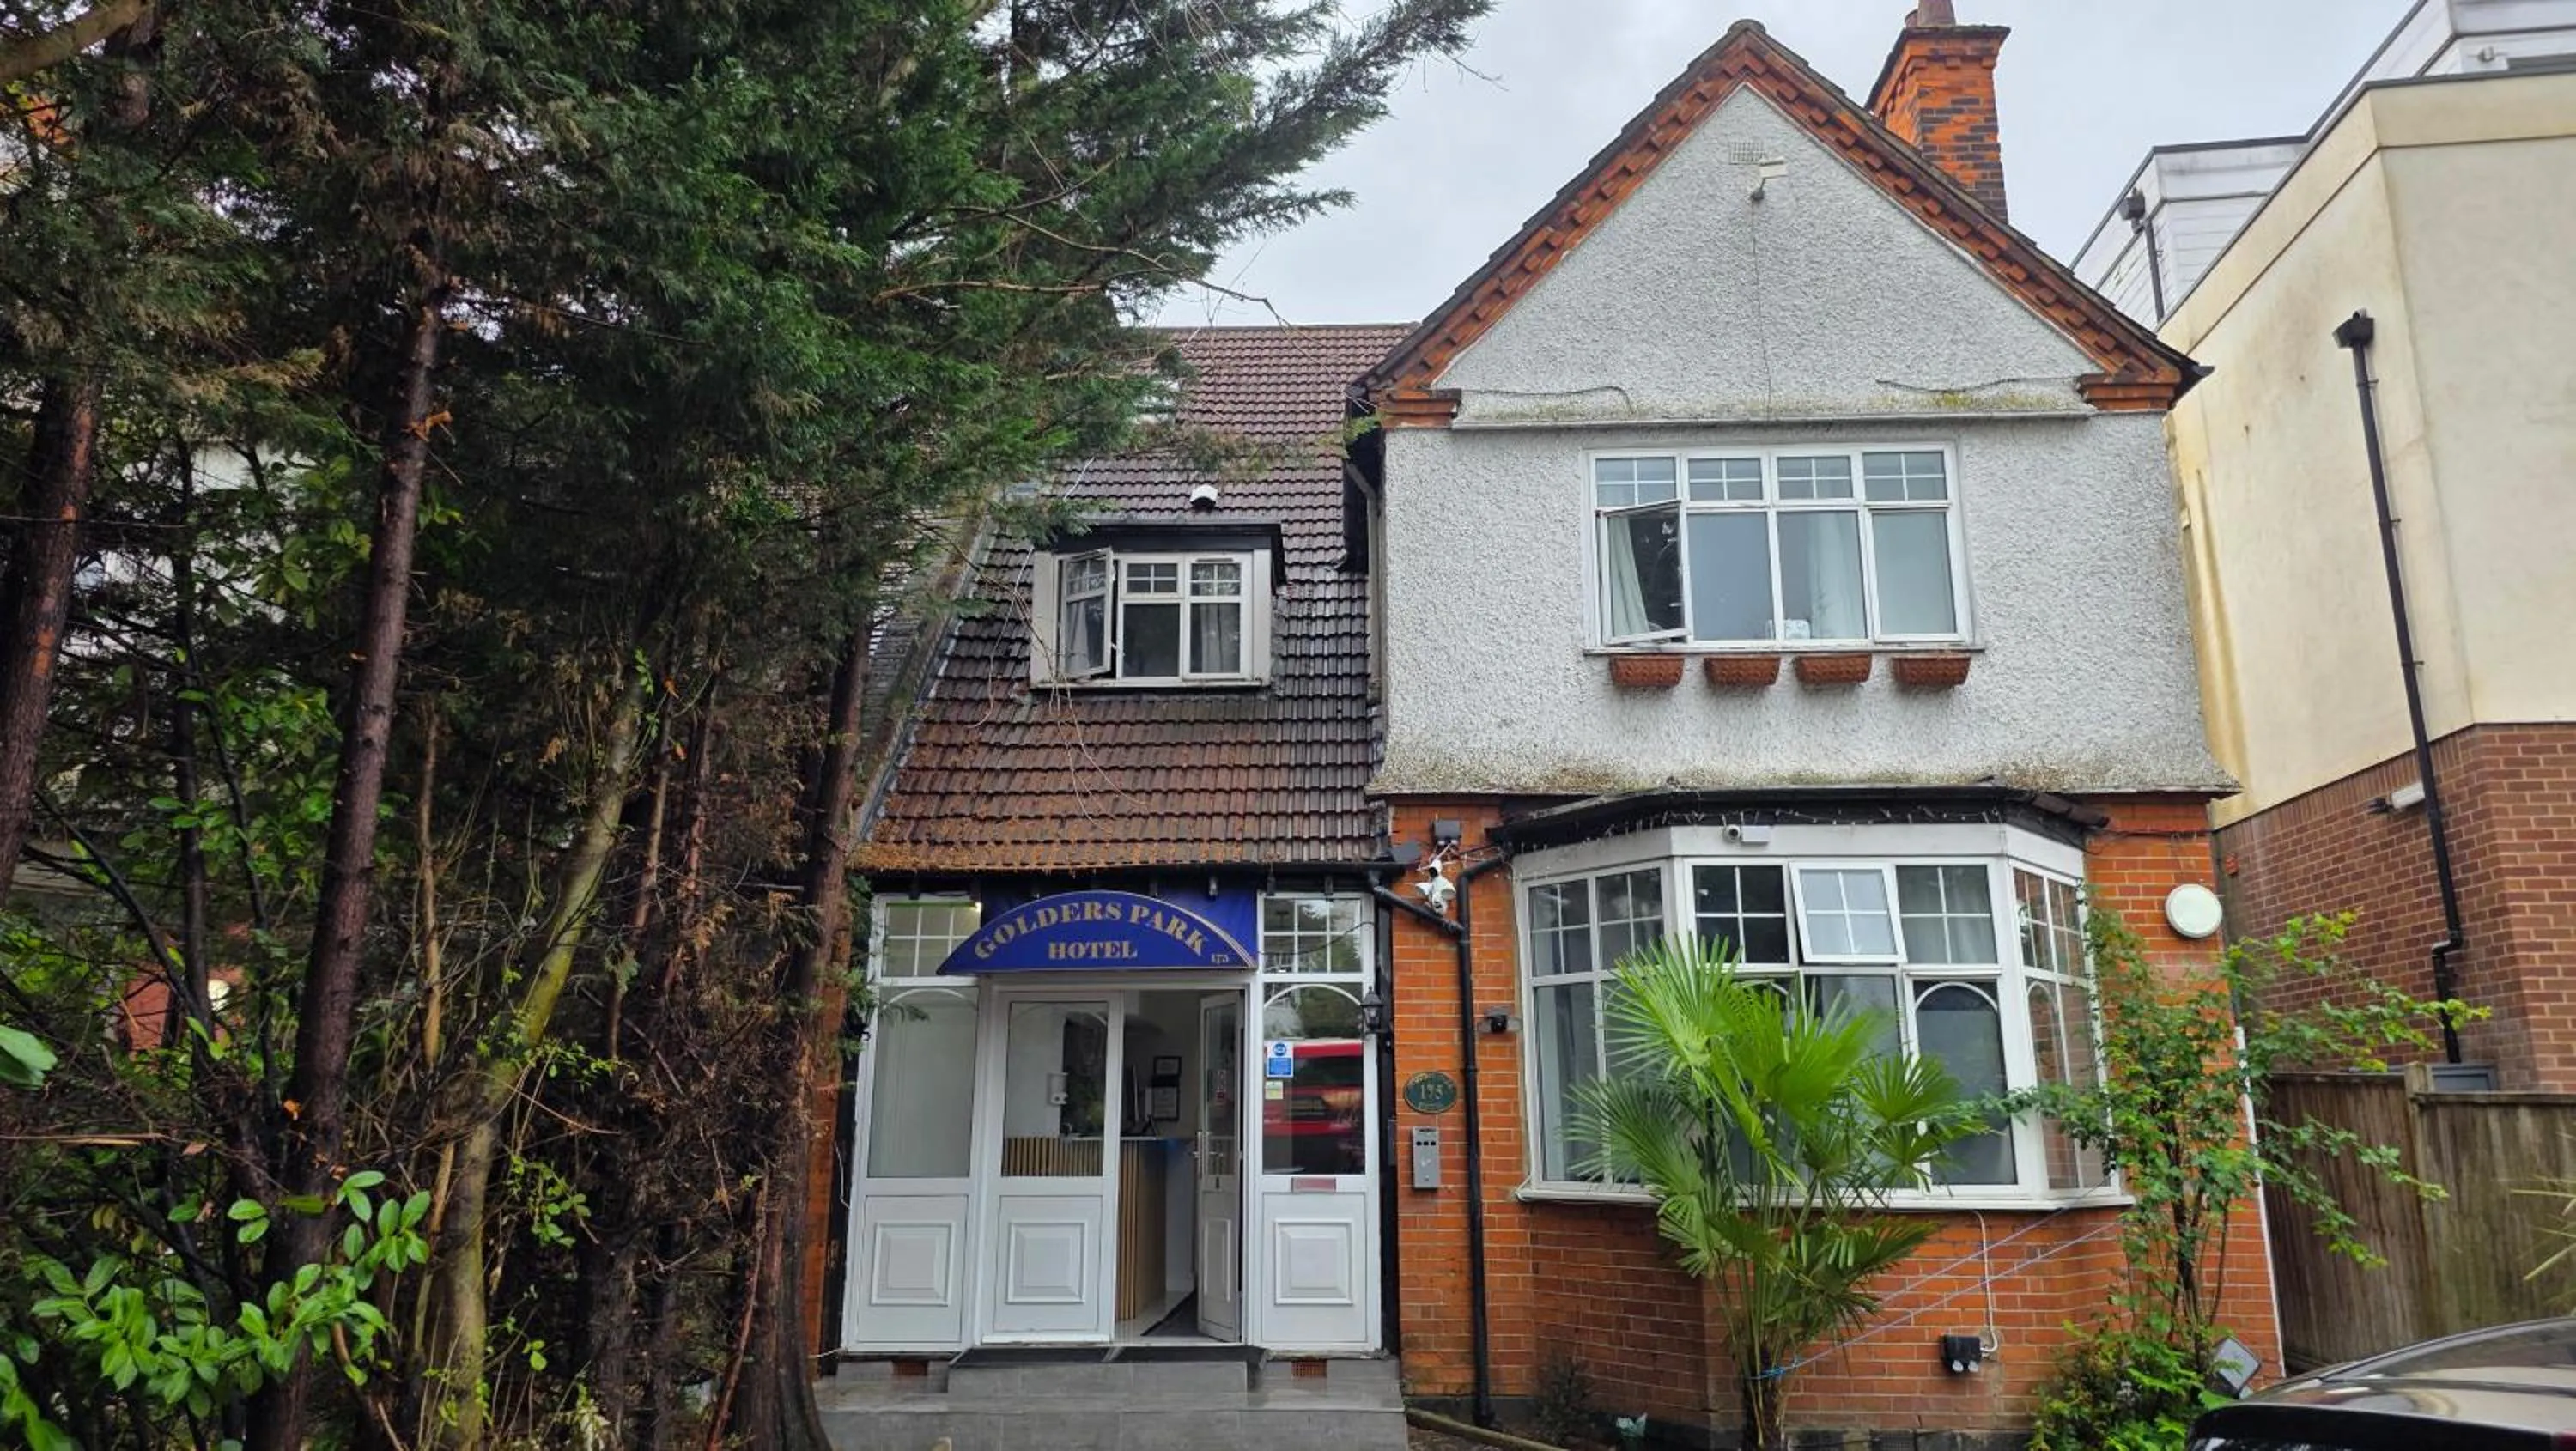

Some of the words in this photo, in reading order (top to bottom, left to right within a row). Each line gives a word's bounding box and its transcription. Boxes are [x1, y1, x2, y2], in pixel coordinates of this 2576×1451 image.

[975, 902, 1122, 959] GOLDERS
[1129, 904, 1209, 956] PARK
[1048, 941, 1138, 960] HOTEL
